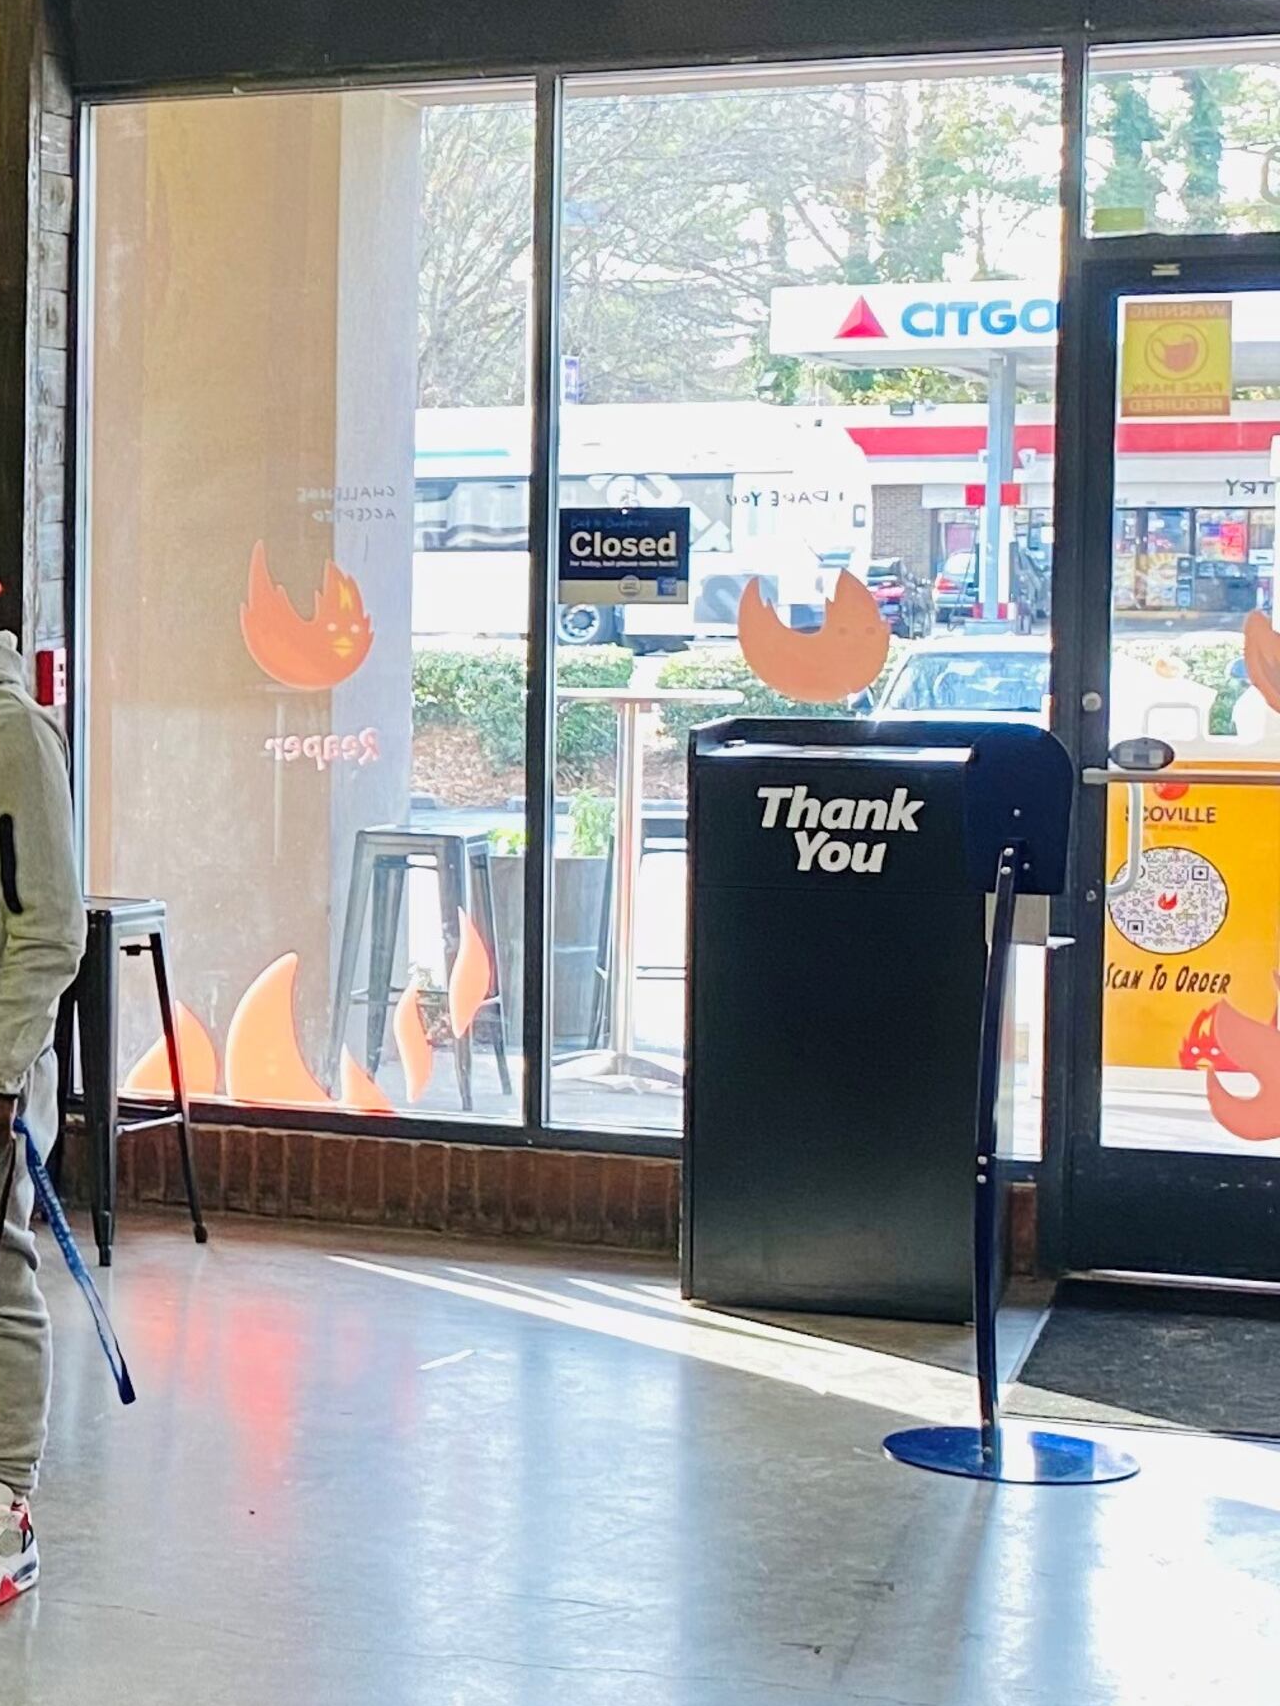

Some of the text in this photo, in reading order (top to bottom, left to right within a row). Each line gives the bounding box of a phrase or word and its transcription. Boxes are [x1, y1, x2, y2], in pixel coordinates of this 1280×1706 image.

[901, 298, 1060, 338] CITGO
[569, 531, 677, 557] Closed
[757, 785, 925, 832] Thank
[1125, 805, 1217, 824] OVILLE
[794, 830, 887, 873] You
